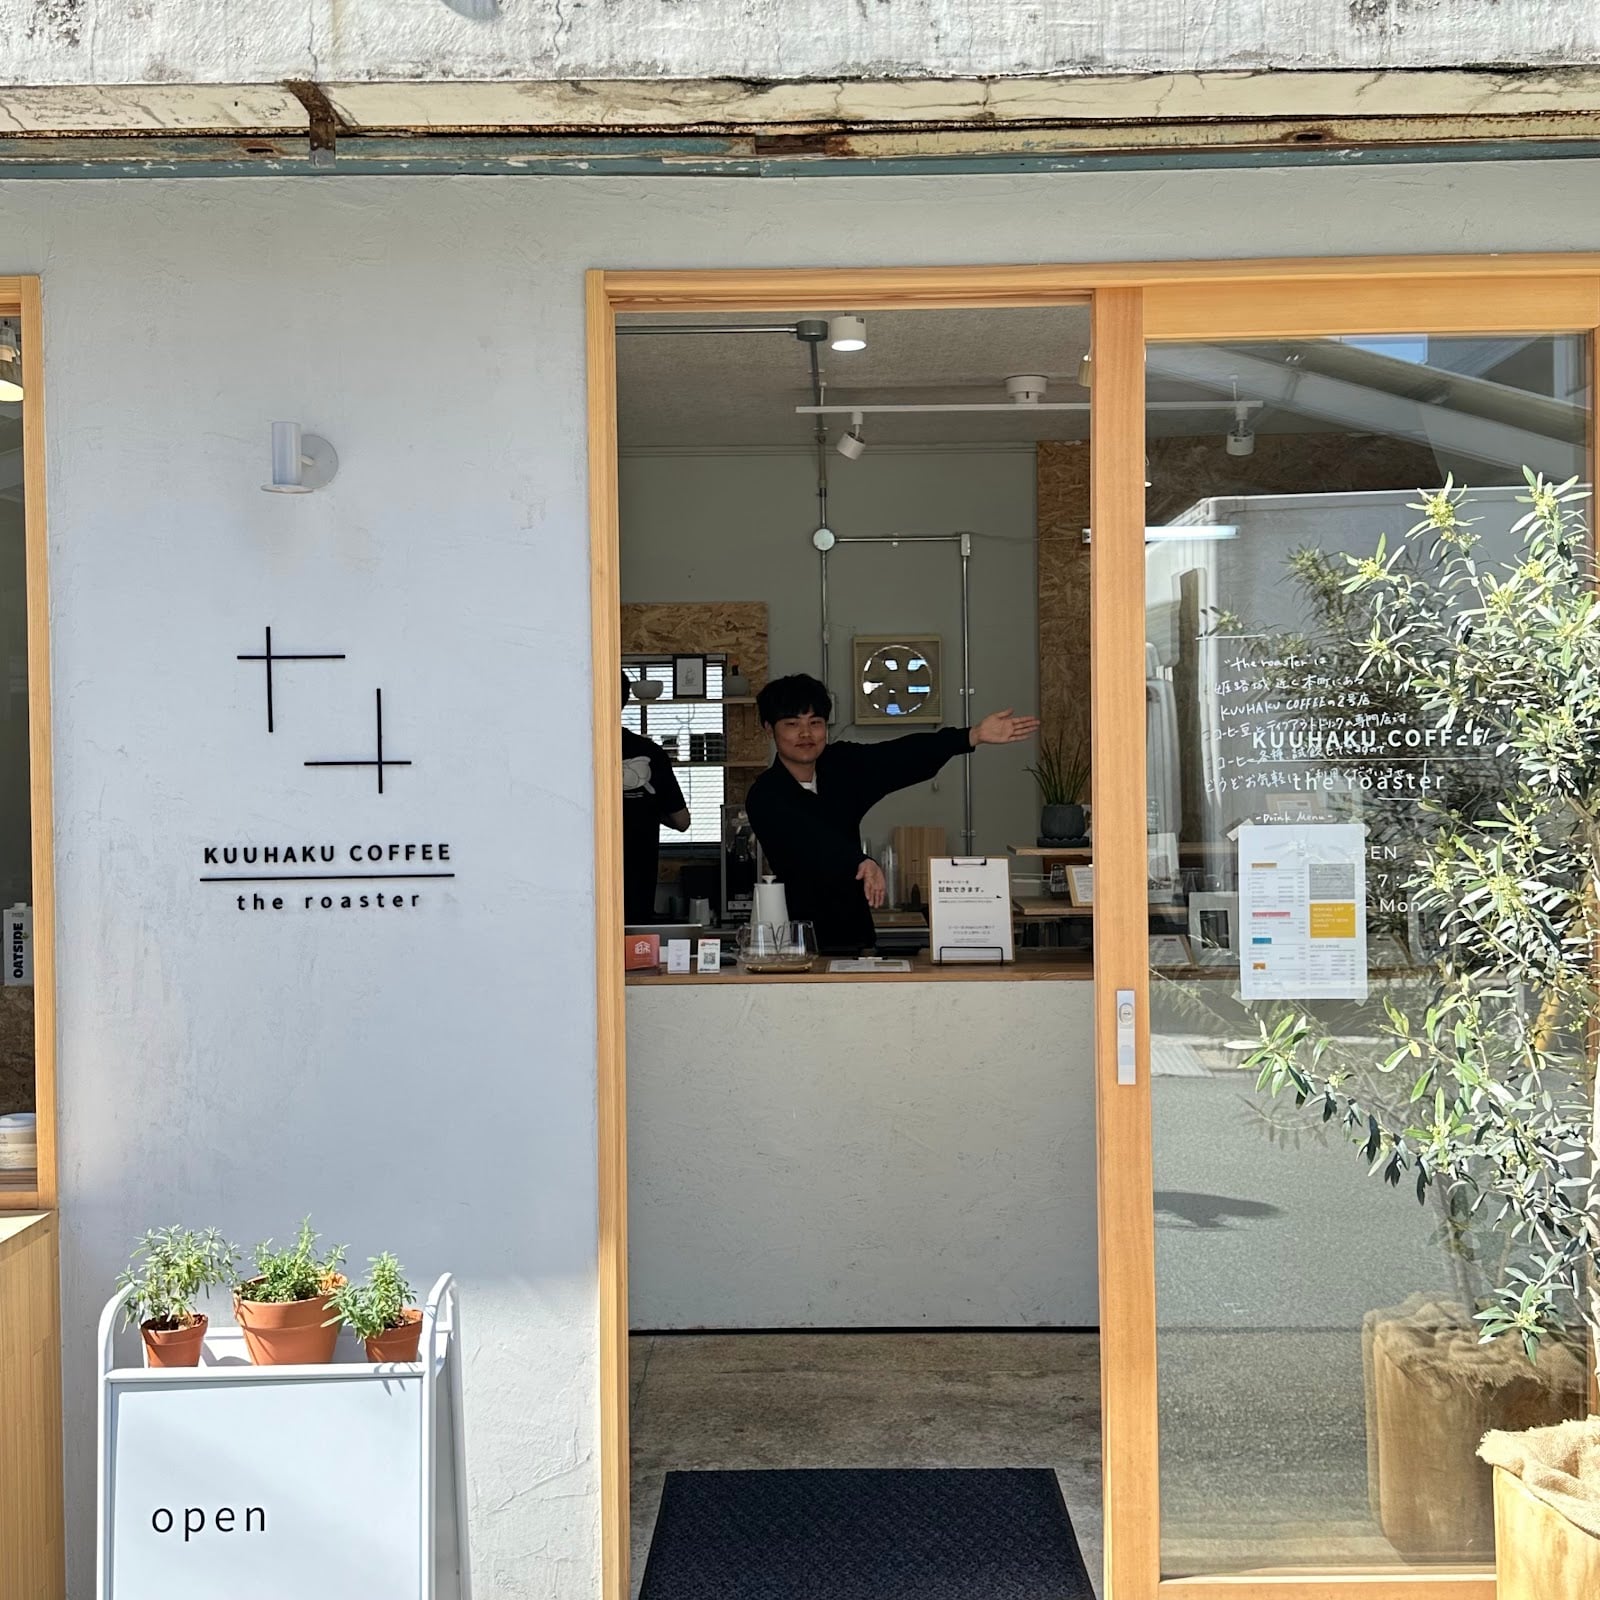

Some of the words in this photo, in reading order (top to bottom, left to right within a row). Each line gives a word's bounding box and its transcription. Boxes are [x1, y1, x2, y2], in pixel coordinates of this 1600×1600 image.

[1220, 701, 1281, 720] KUUHAKU
[1253, 730, 1376, 748] KUUHAKU
[1293, 771, 1334, 791] the
[1347, 774, 1445, 790] roaster
[204, 846, 336, 864] KUUHAKU
[349, 844, 451, 861] COFFEE
[237, 894, 284, 910] the
[304, 892, 420, 909] roaster
[1380, 899, 1420, 912] Mon
[13, 922, 24, 978] OATSIDE
[151, 1507, 265, 1542] open
